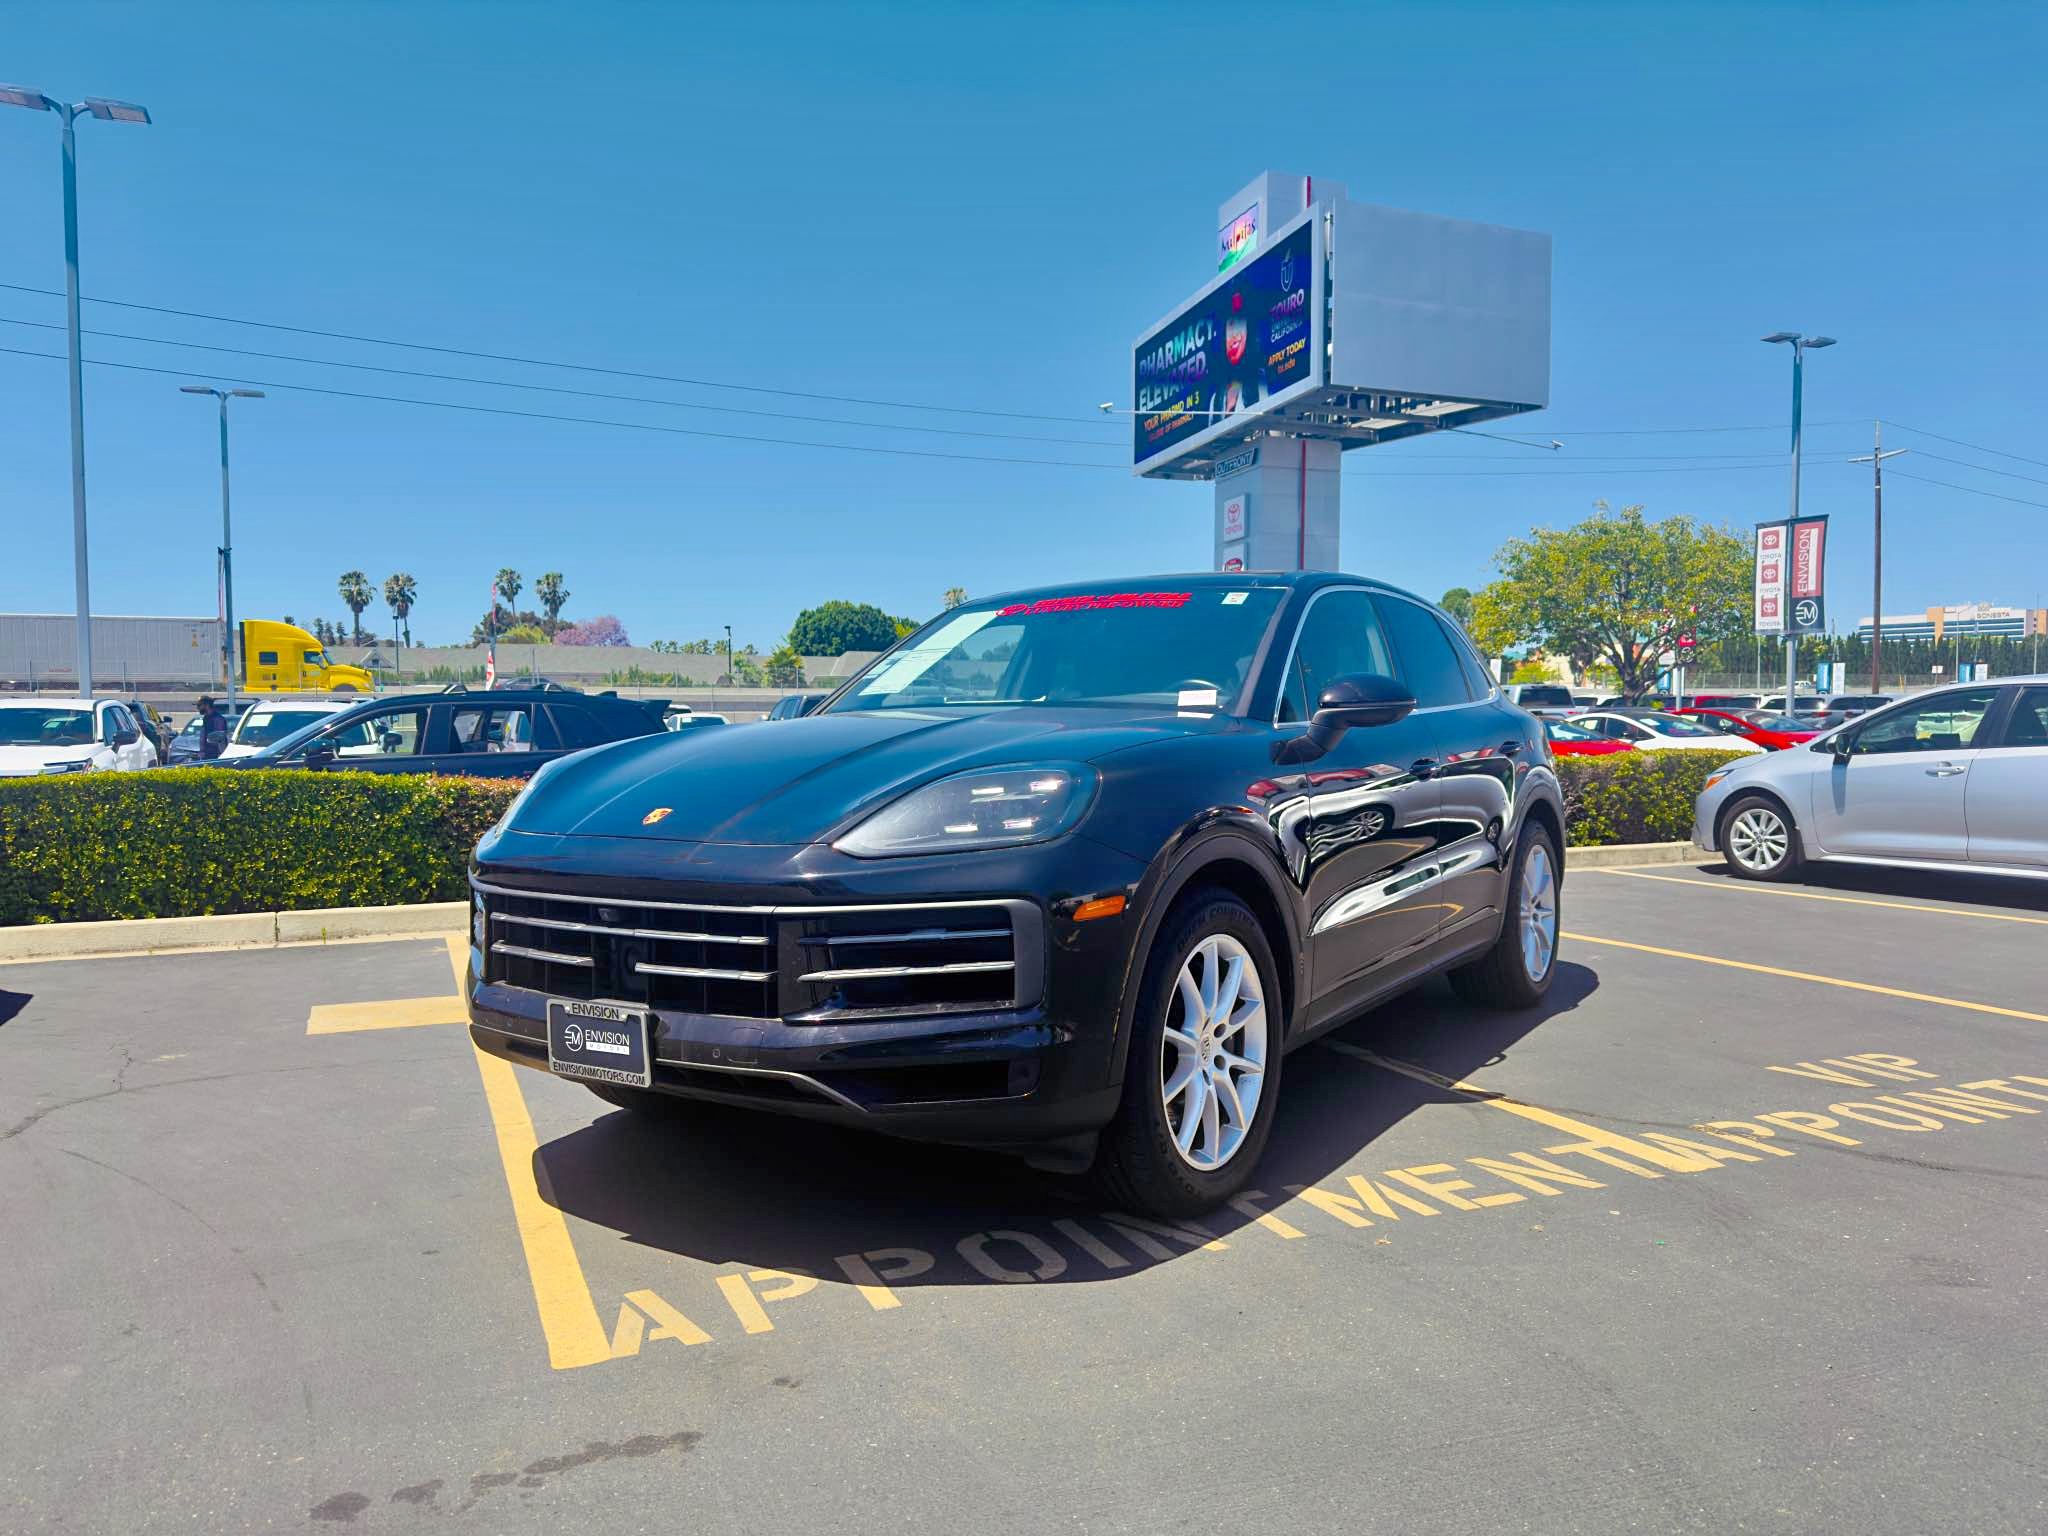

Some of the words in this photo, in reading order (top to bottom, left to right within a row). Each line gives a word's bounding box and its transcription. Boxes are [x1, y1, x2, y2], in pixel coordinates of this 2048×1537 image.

[1267, 349, 1285, 366] APPLY
[1285, 337, 1306, 356] TODAY
[1144, 415, 1160, 432] YOUR
[1797, 528, 1811, 593] ENVISION
[1976, 611, 2010, 619] SONESTA
[572, 1003, 619, 1020] ENVISION
[585, 1029, 630, 1046] ENVISION
[553, 1061, 646, 1086] ENVISIONMOTORS.COM
[1764, 1053, 1941, 1088] VIP
[1638, 1075, 2048, 1168] APPOINT
[610, 1141, 1665, 1356] APPOINTMENT
